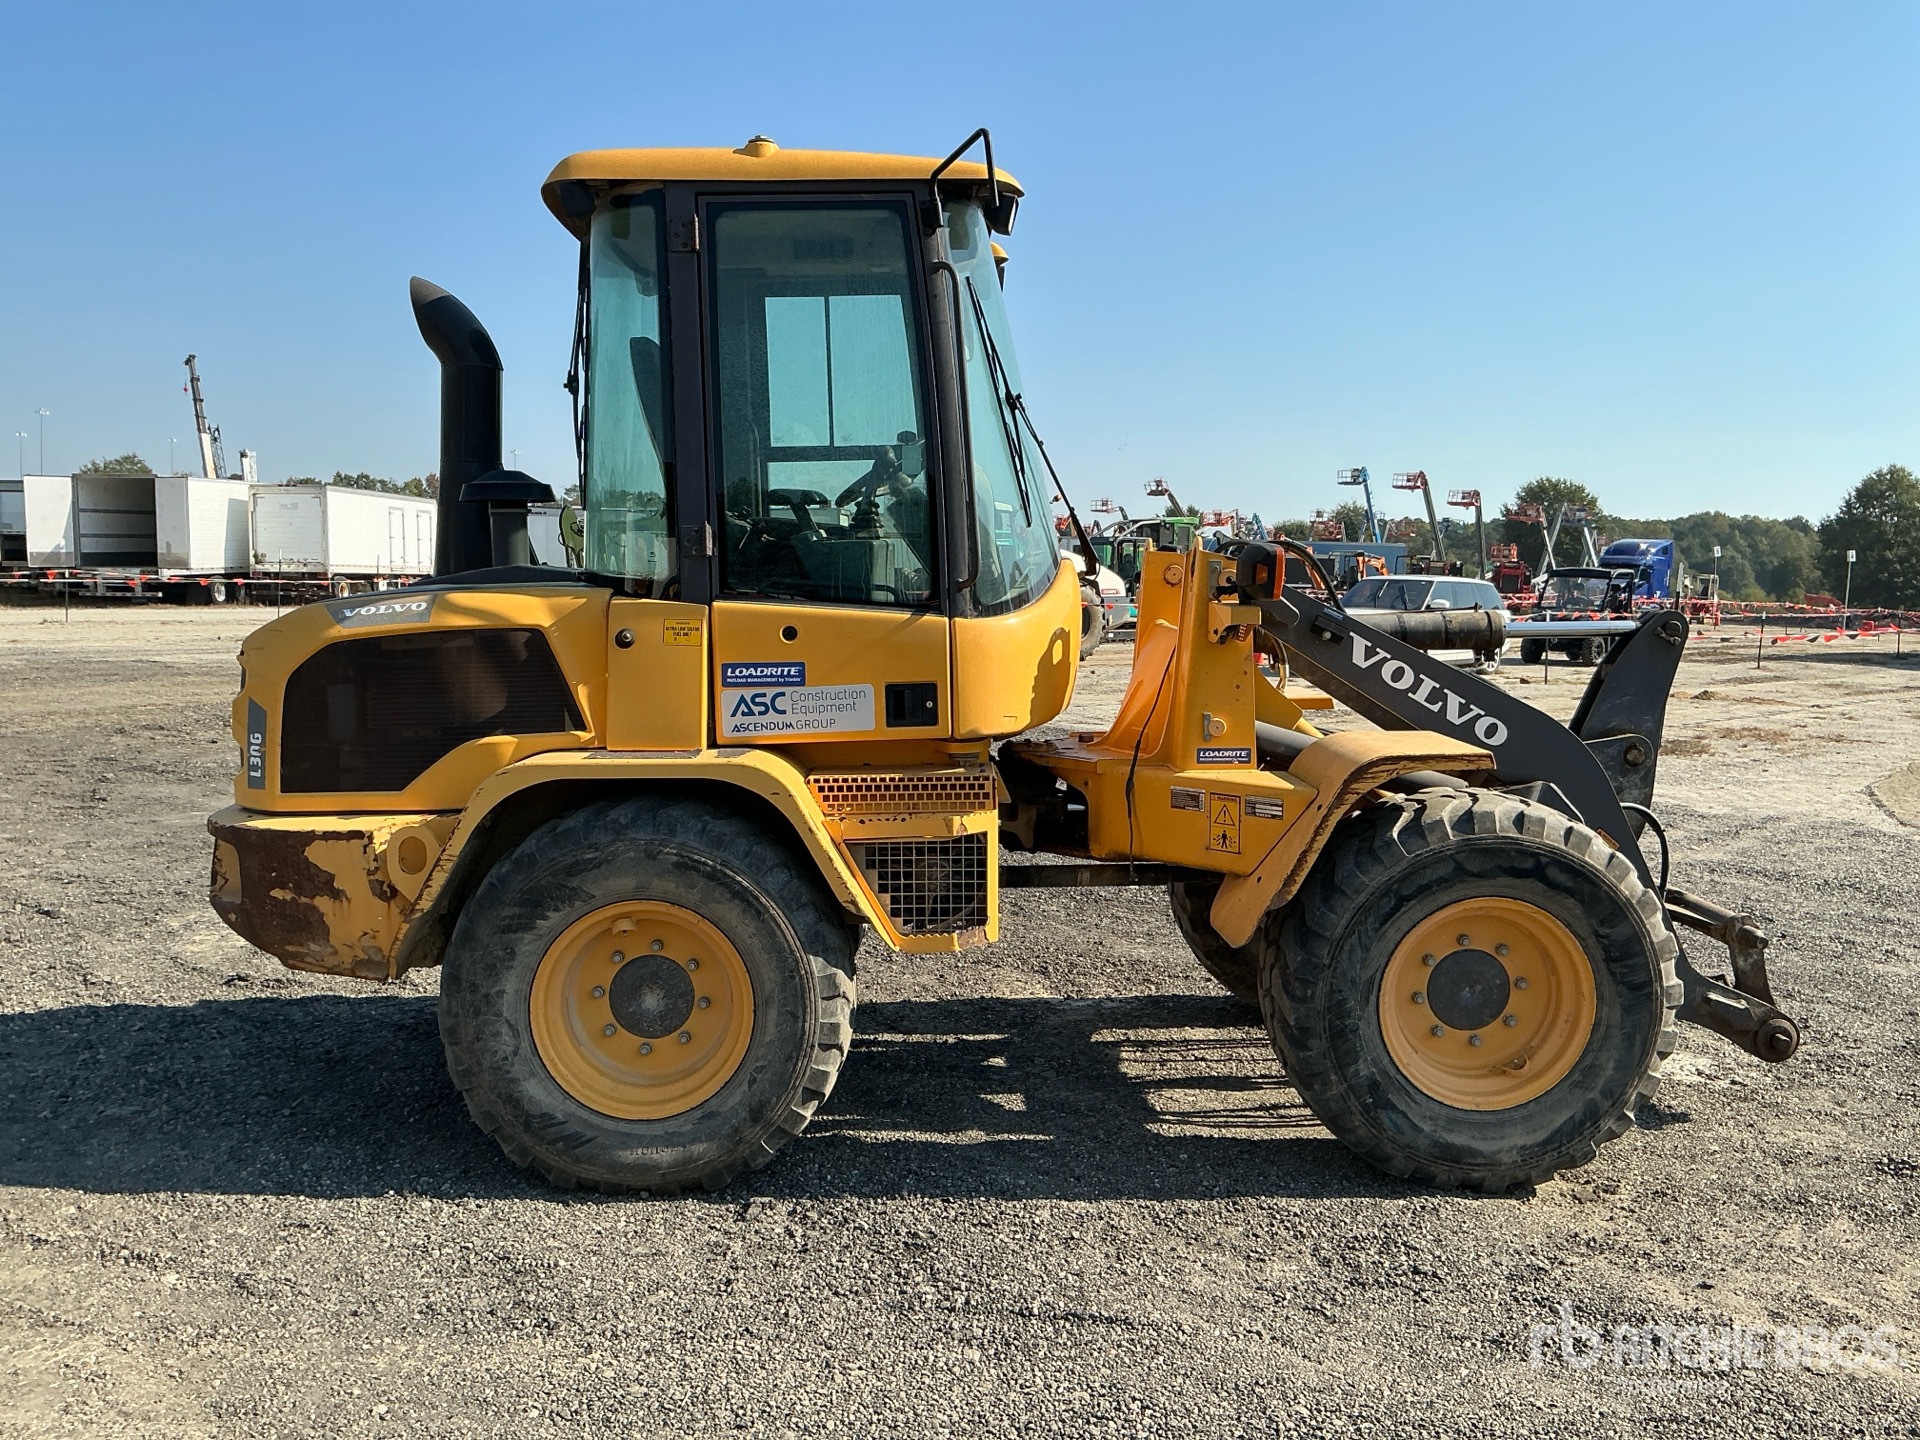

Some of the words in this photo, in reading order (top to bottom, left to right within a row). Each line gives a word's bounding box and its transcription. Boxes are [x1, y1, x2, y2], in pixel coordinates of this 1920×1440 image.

[342, 602, 427, 617] VOLVO
[727, 667, 800, 677] LOADRITE
[790, 688, 867, 703] Construction
[1349, 631, 1508, 746] VOLVO
[730, 691, 787, 717] ASC
[791, 700, 857, 716] Equipment
[250, 732, 262, 778] L30G
